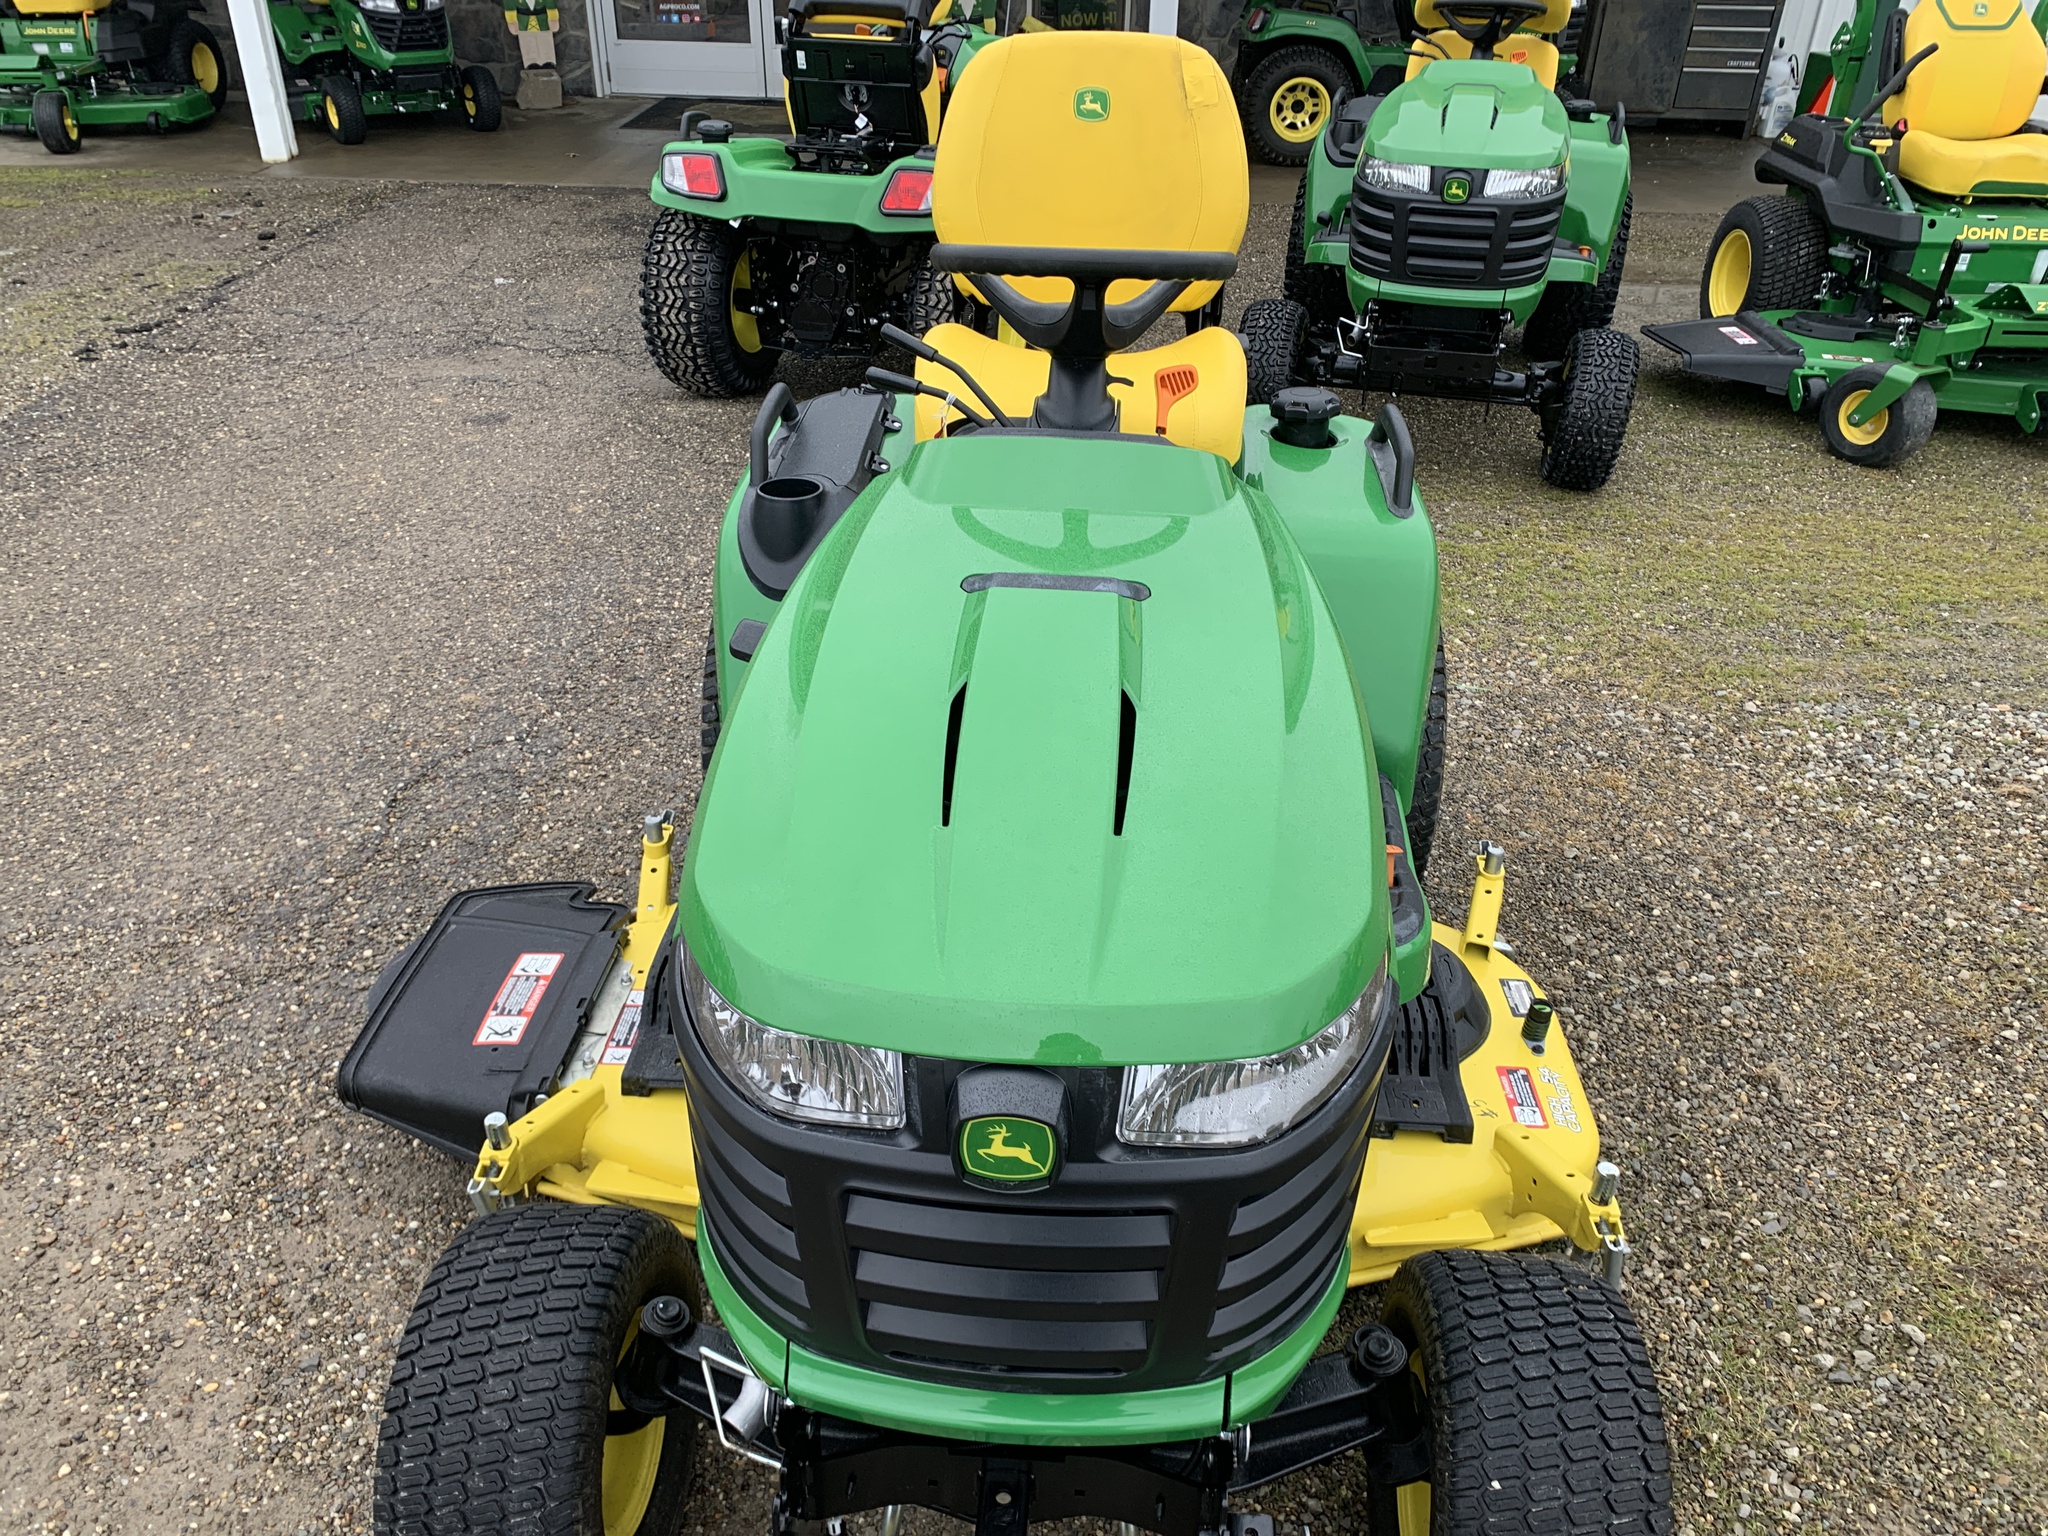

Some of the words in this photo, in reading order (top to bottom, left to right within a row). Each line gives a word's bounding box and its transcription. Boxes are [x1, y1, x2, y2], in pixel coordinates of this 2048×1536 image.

[1060, 12, 1098, 28] NOW
[23, 26, 46, 35] JOHN
[46, 26, 76, 35] DEERE
[1956, 224, 2009, 240] JOHN
[1537, 1066, 1554, 1085] 54
[1550, 1069, 1582, 1133] CAPACITY
[1547, 1096, 1568, 1127] HIGH
